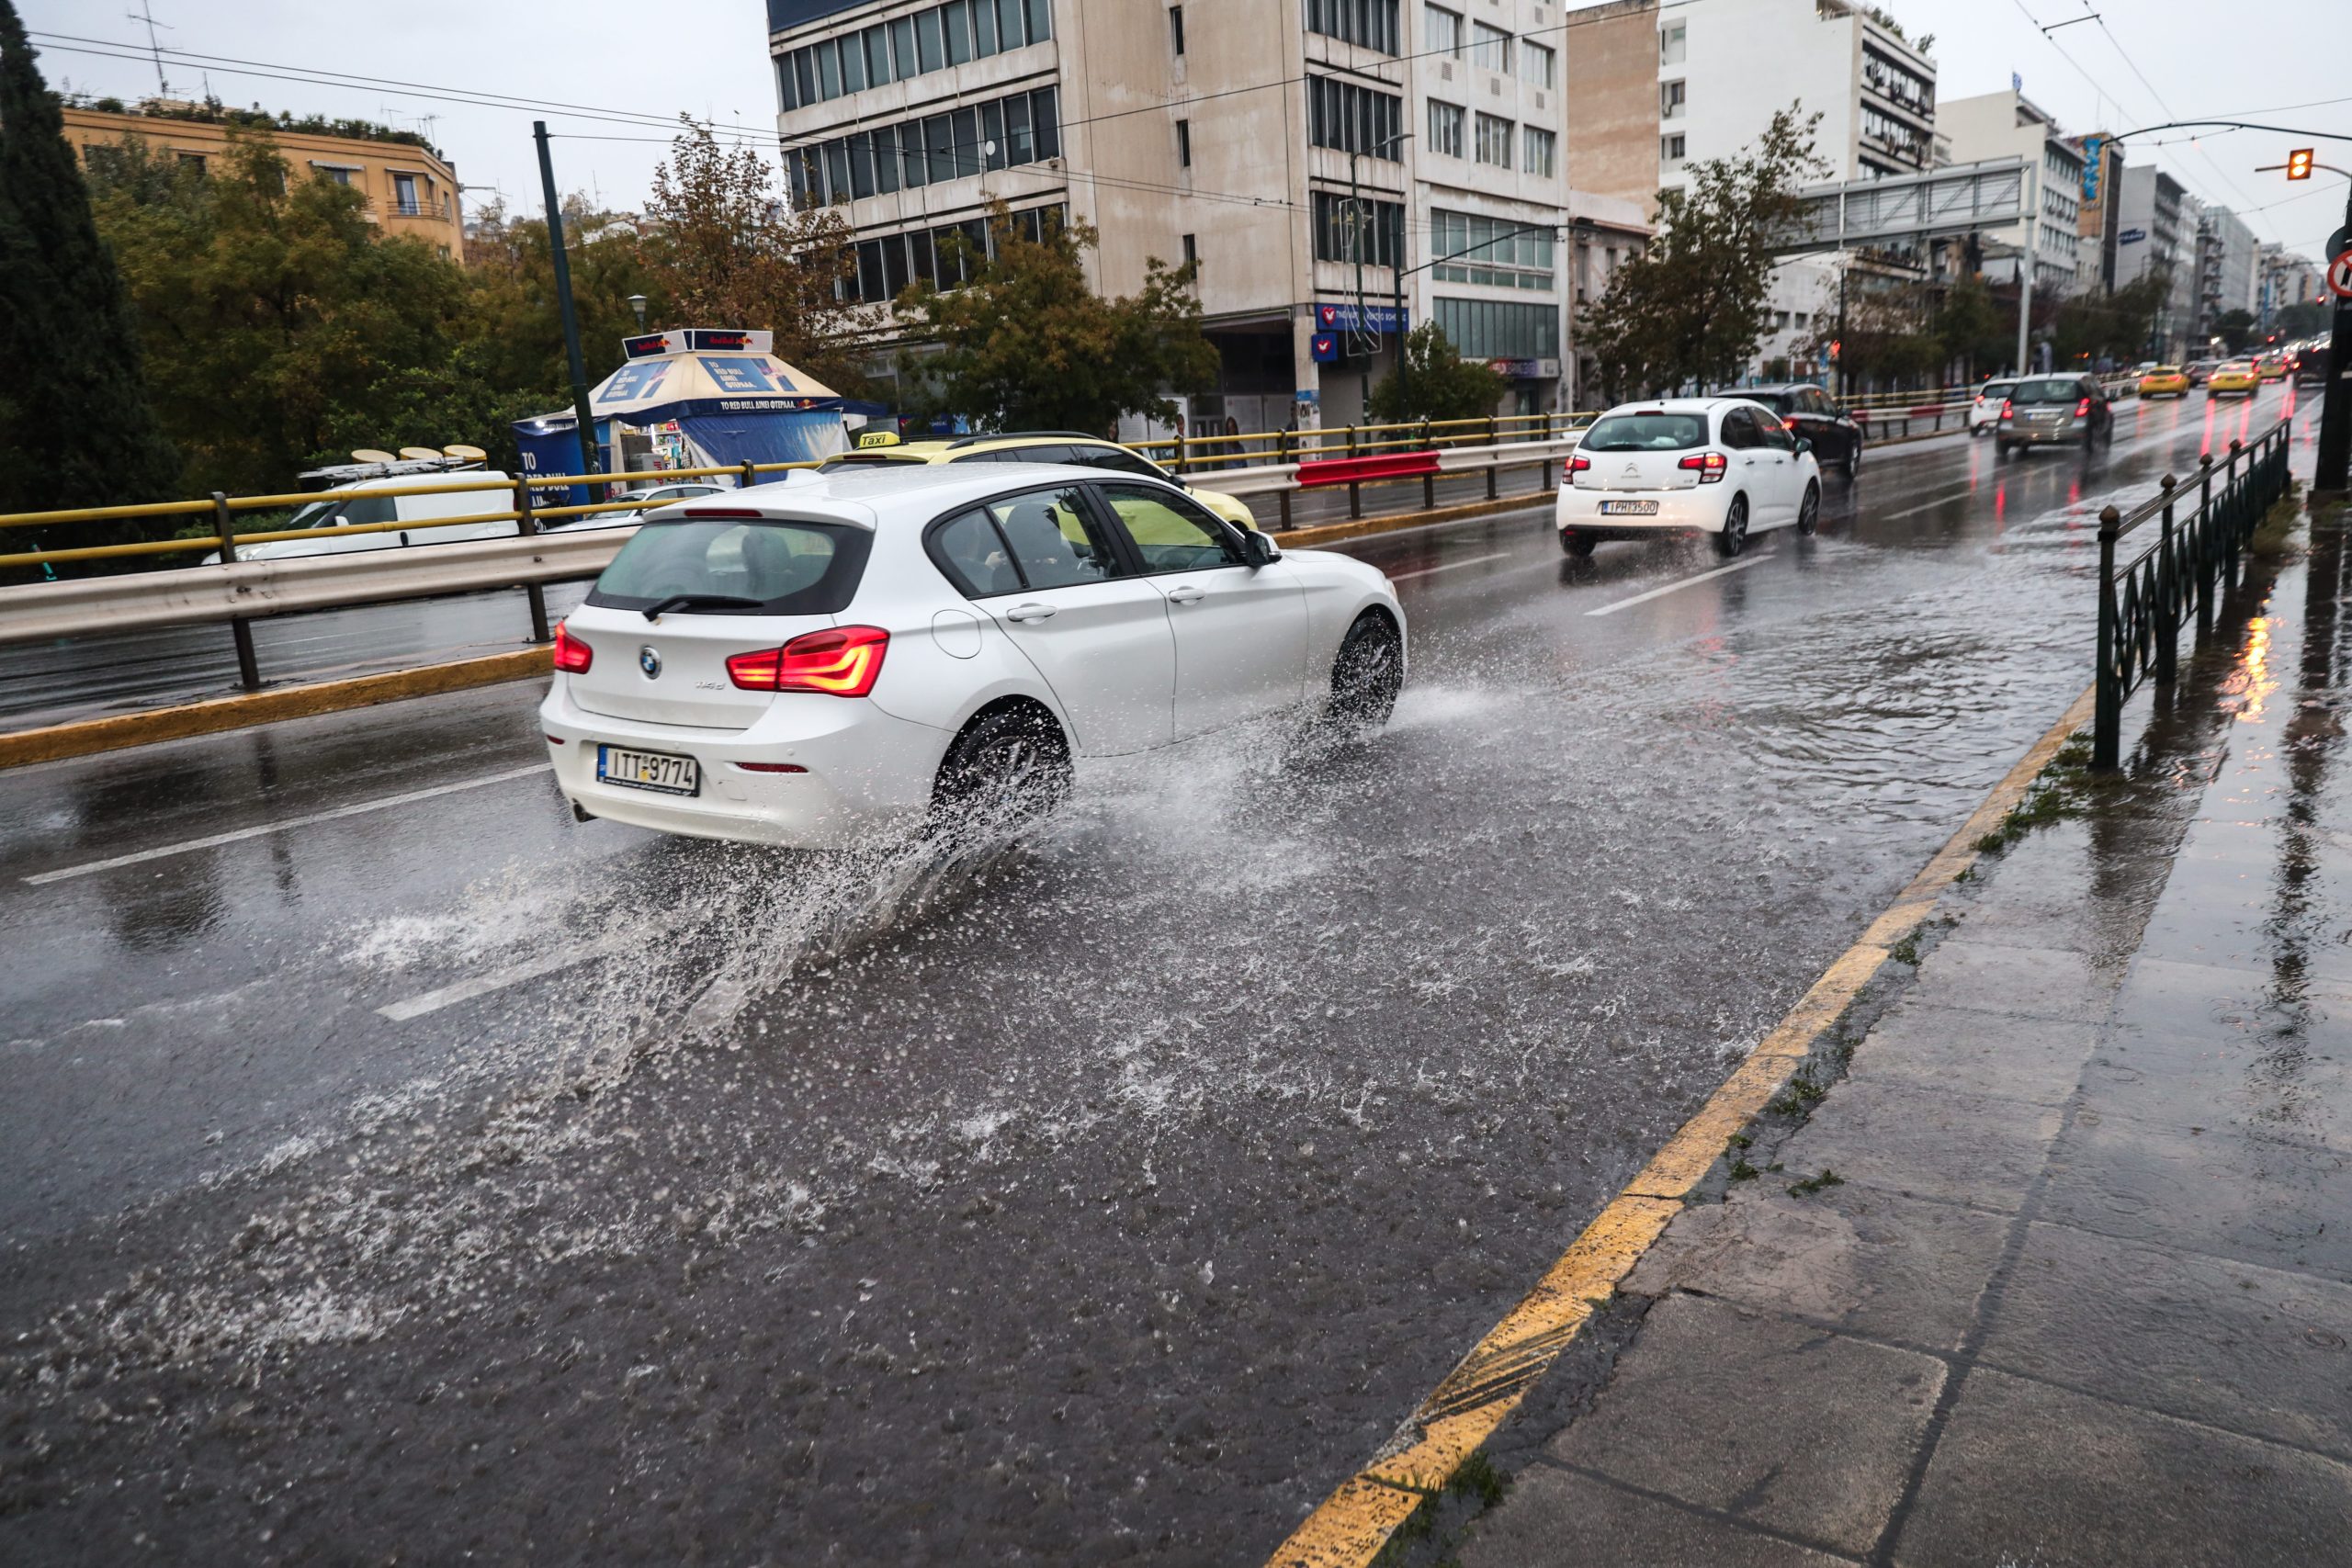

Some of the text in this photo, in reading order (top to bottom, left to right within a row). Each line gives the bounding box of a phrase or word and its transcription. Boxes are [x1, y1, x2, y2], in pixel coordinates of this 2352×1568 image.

[720, 401, 729, 411] ΤΟ
[729, 400, 741, 410] RED
[741, 400, 755, 410] BULL
[862, 434, 887, 446] Taxi
[522, 452, 537, 470] ΤΟ
